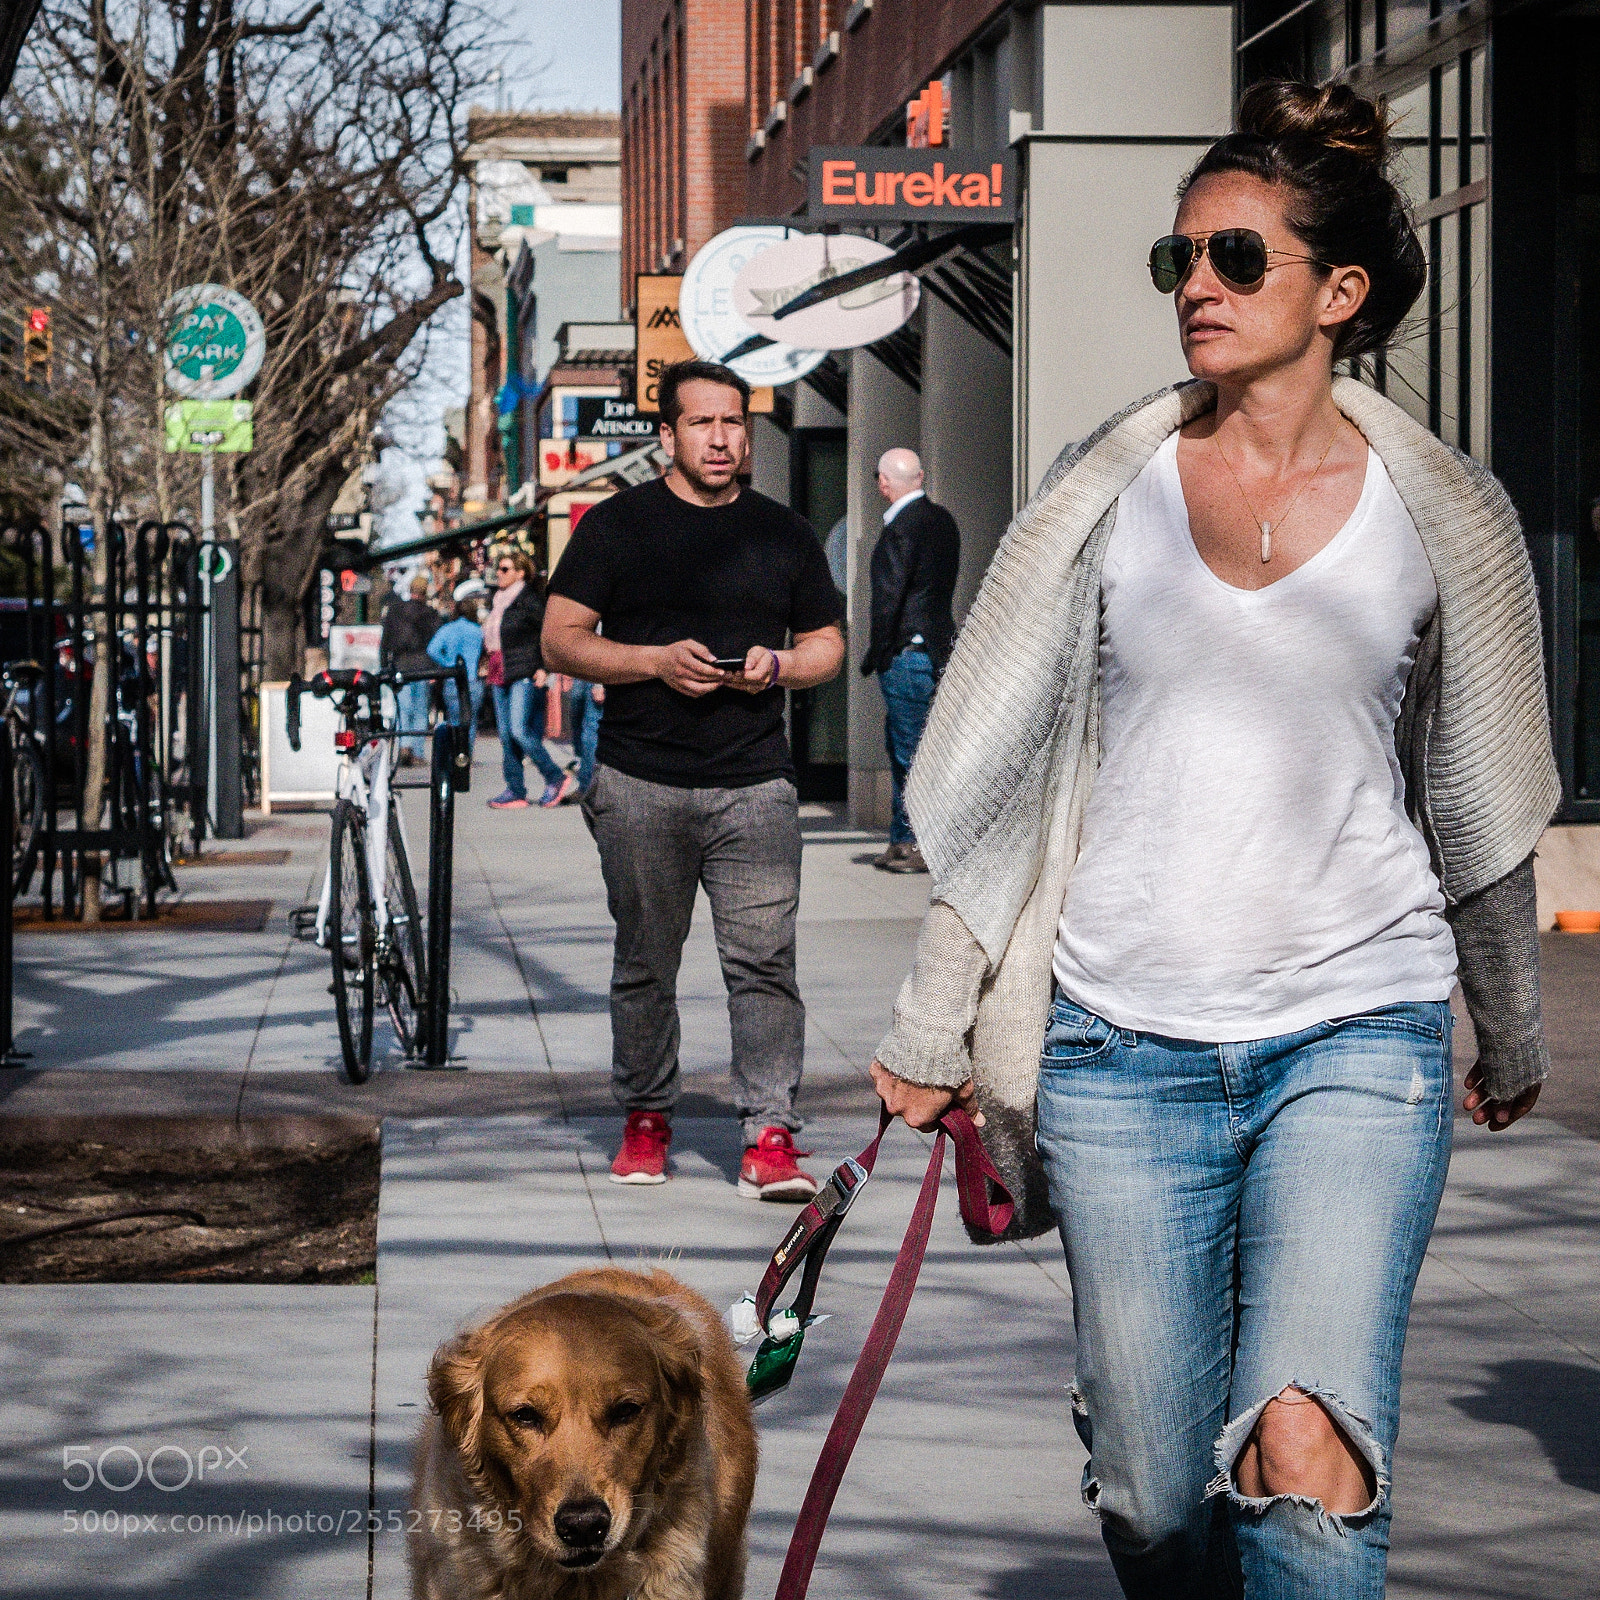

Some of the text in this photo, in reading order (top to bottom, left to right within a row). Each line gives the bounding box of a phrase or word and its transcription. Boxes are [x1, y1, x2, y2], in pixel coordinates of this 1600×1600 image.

[822, 160, 1003, 207] Eureka!
[183, 314, 228, 331] PAY
[172, 343, 240, 360] PARK
